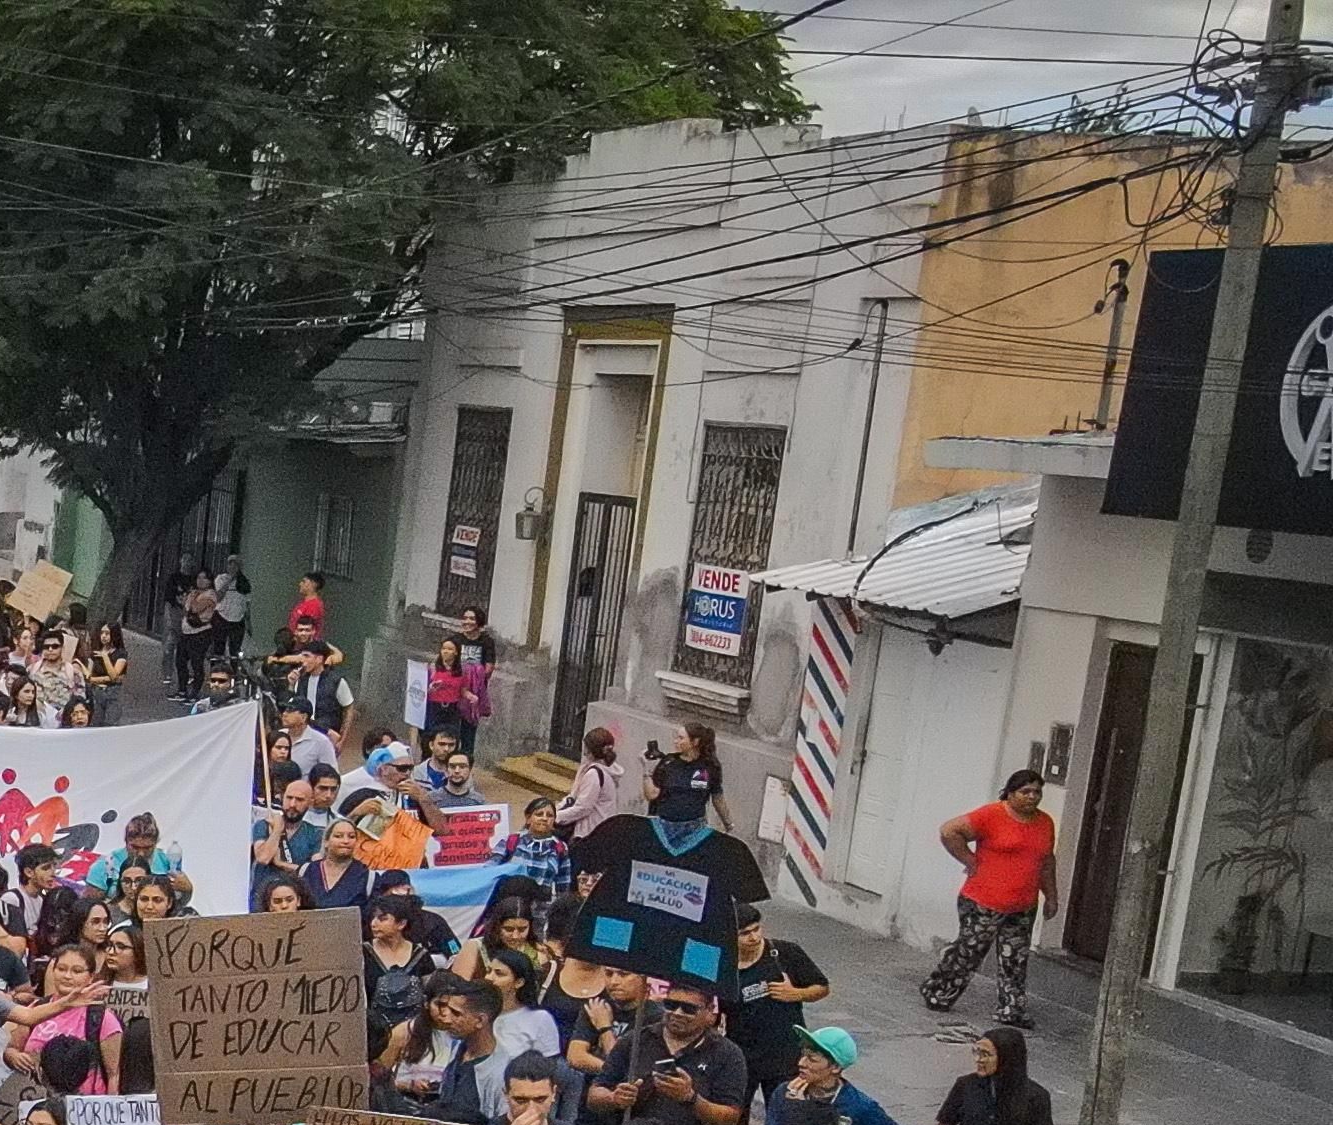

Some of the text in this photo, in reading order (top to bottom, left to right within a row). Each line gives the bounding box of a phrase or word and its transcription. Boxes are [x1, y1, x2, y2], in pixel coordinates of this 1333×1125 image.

[697, 569, 741, 593] VENDE
[693, 595, 737, 620] HORUS
[174, 977, 270, 1014] TANTO
[281, 972, 361, 1016] MIEDO
[169, 1017, 343, 1061] DE EDUCAR
[179, 1079, 220, 1114] AL
[104, 1101, 126, 1125] QUE
